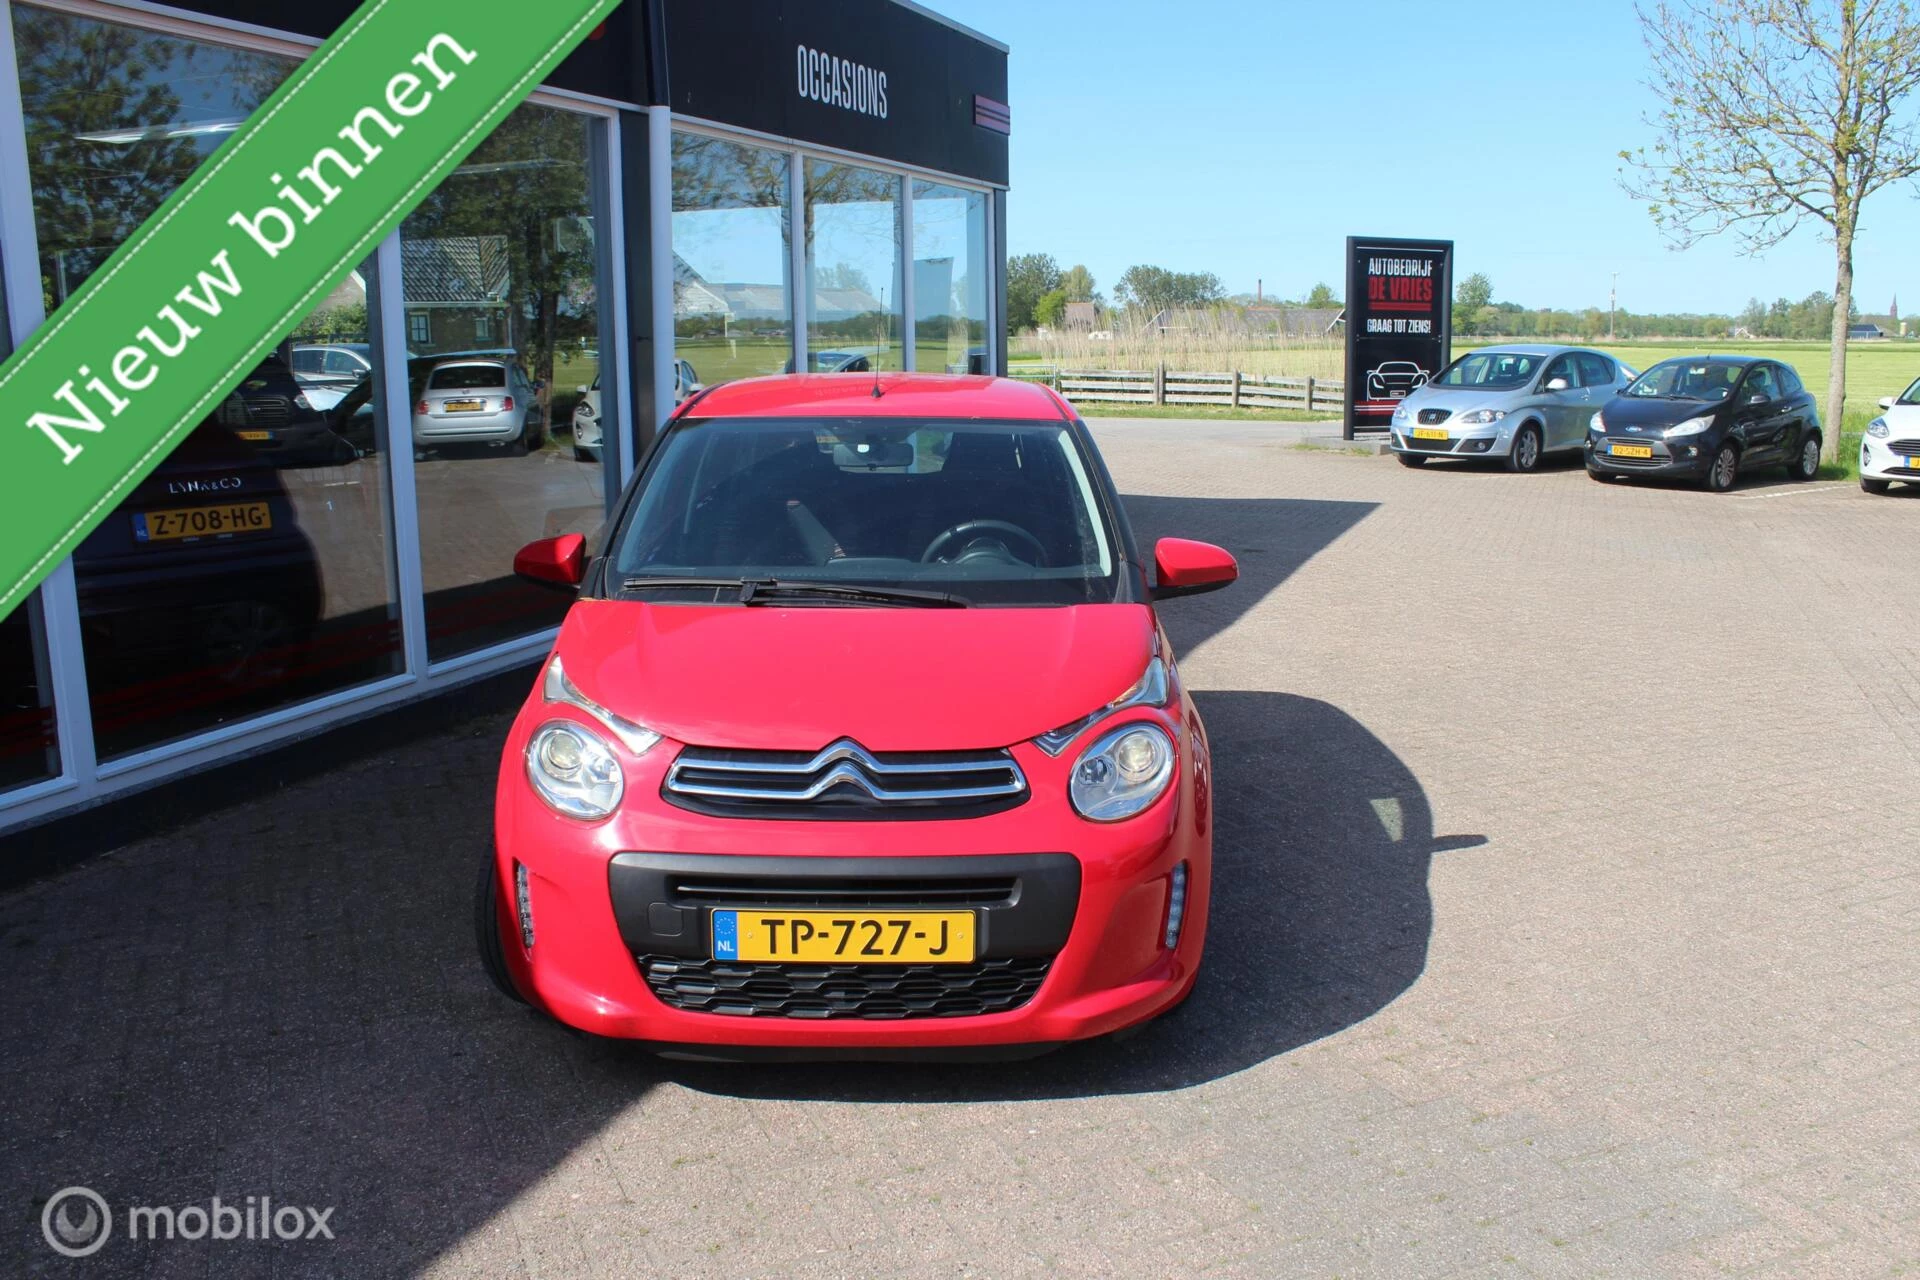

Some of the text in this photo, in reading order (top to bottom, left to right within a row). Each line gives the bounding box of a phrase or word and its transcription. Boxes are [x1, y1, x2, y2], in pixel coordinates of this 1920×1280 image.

[797, 44, 887, 119] OCCASIONS
[1368, 257, 1433, 276] AUTOBEDRIJF
[1369, 276, 1432, 302] DE VRIES
[1367, 318, 1431, 334] GRAAG TOT ZIENS!
[154, 507, 264, 535] Z-708-HG
[717, 941, 734, 952] NL
[761, 919, 949, 956] TP-727-J
